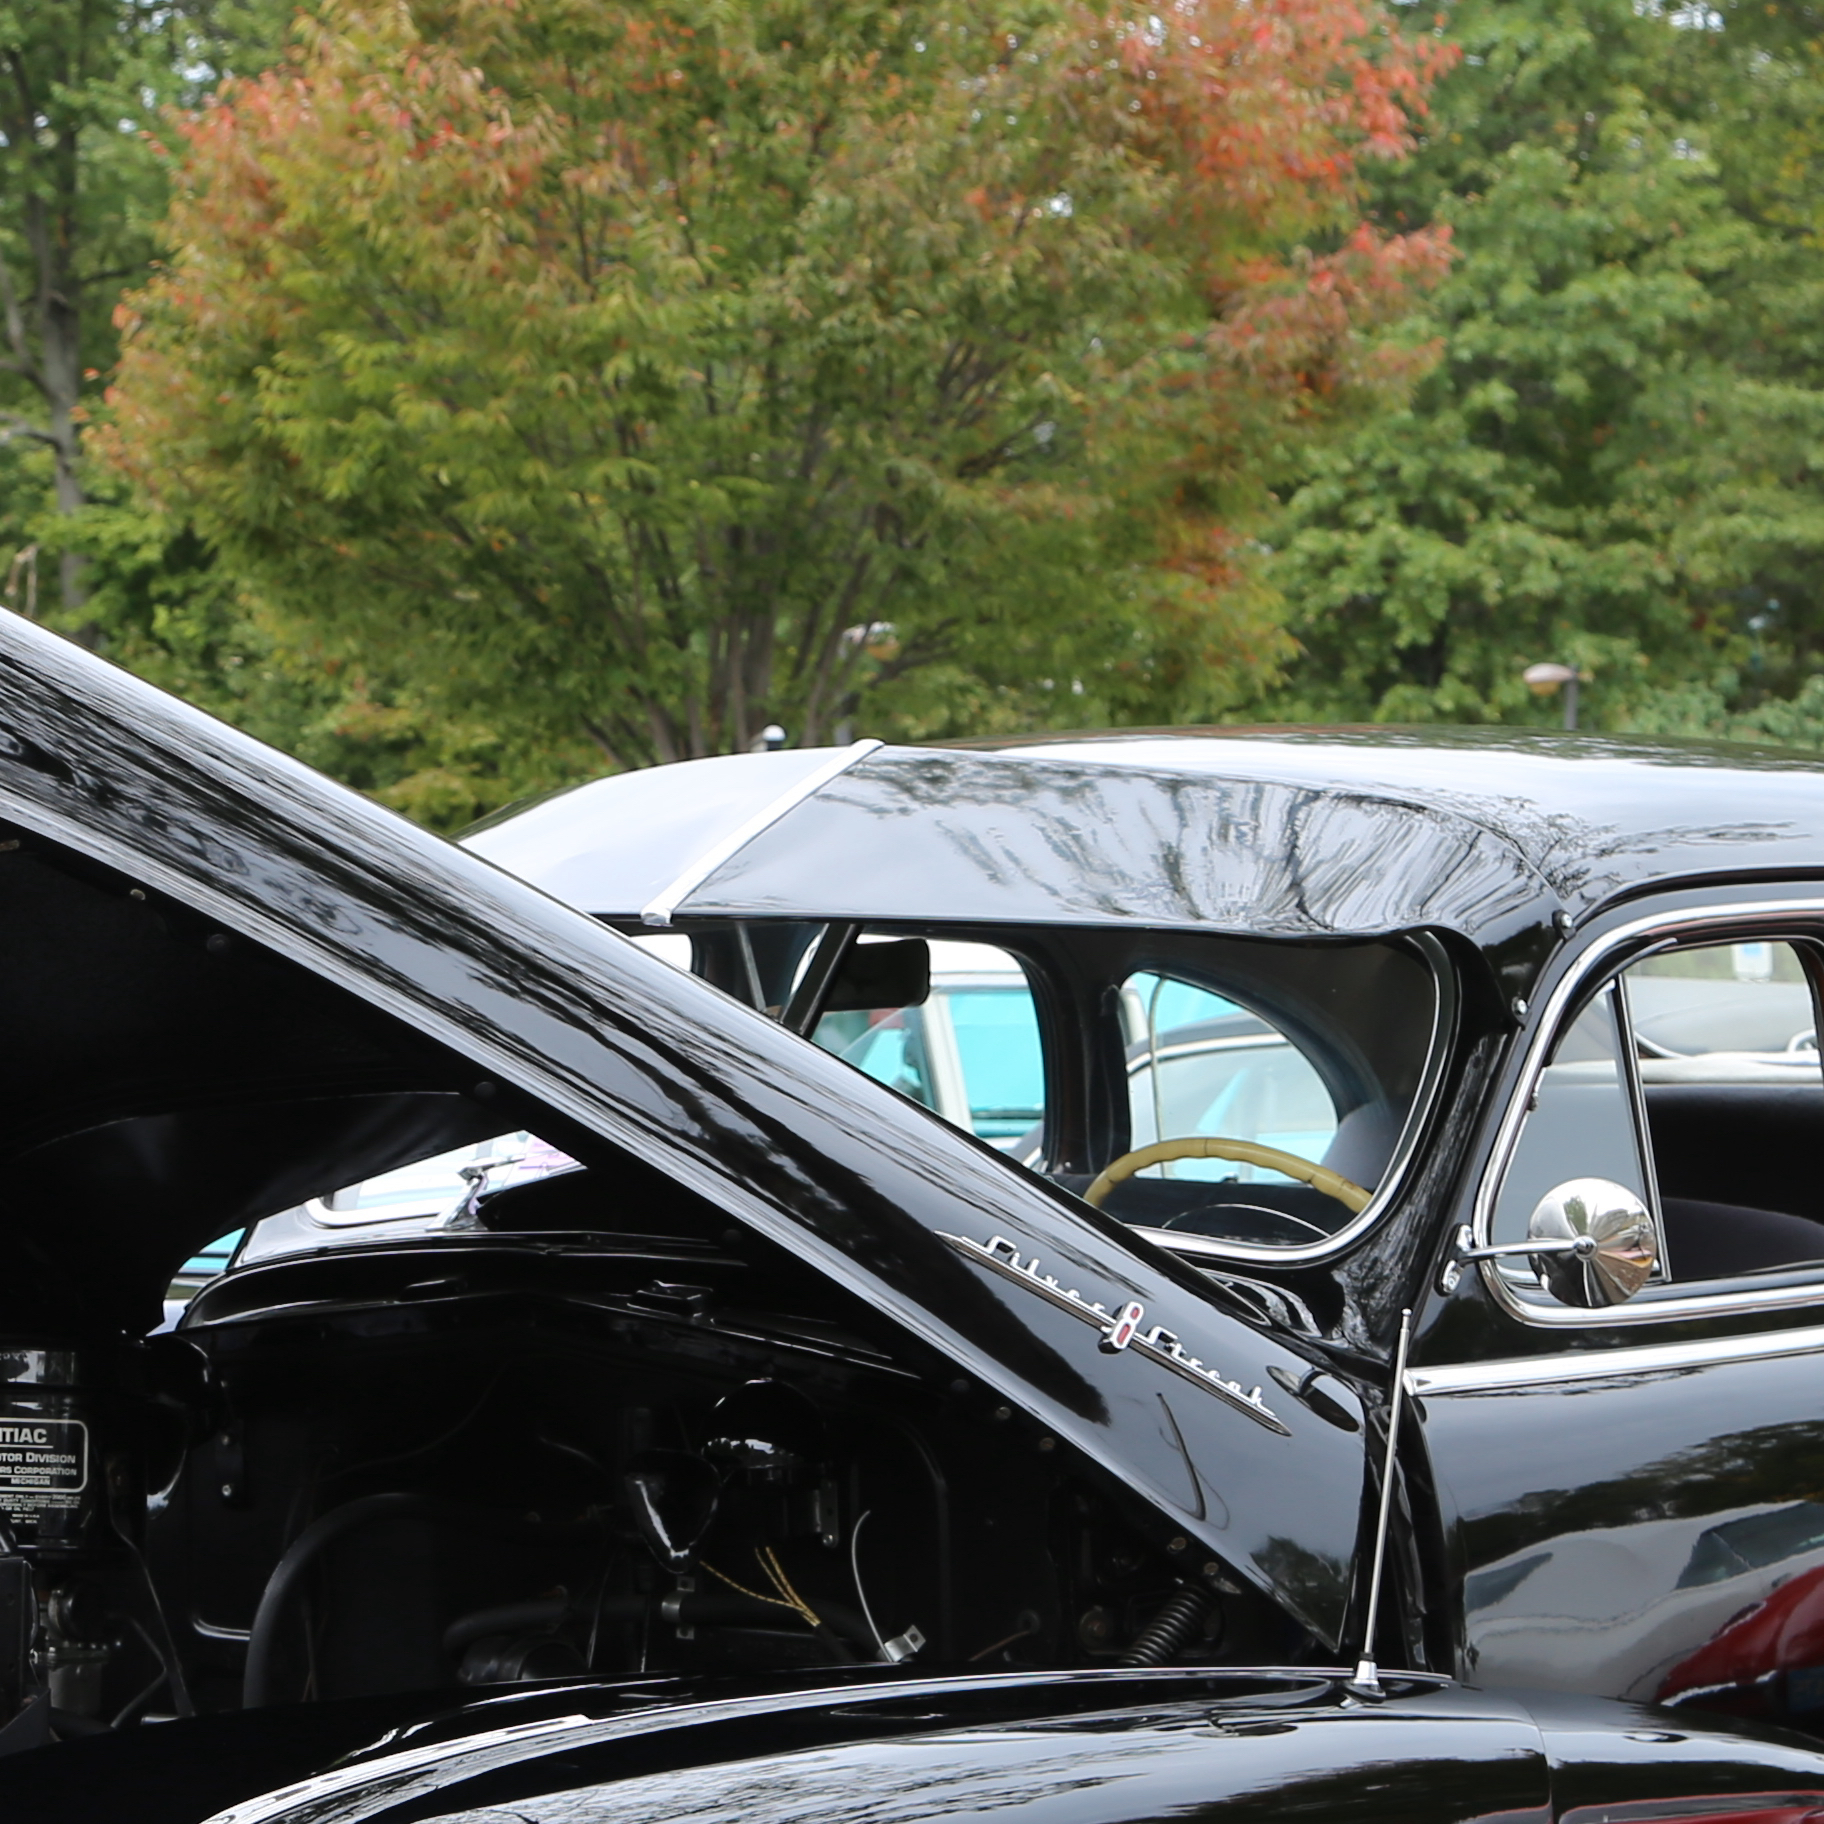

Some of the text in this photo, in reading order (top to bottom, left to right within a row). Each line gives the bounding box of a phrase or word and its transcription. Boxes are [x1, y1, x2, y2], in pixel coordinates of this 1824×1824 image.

[986, 1234, 1106, 1312] Silver
[1145, 1325, 1265, 1406] Streak
[26, 1452, 76, 1464] DIVISION
[14, 1465, 78, 1476] CORPORATION
[11, 1477, 51, 1486] MICHIGAN
